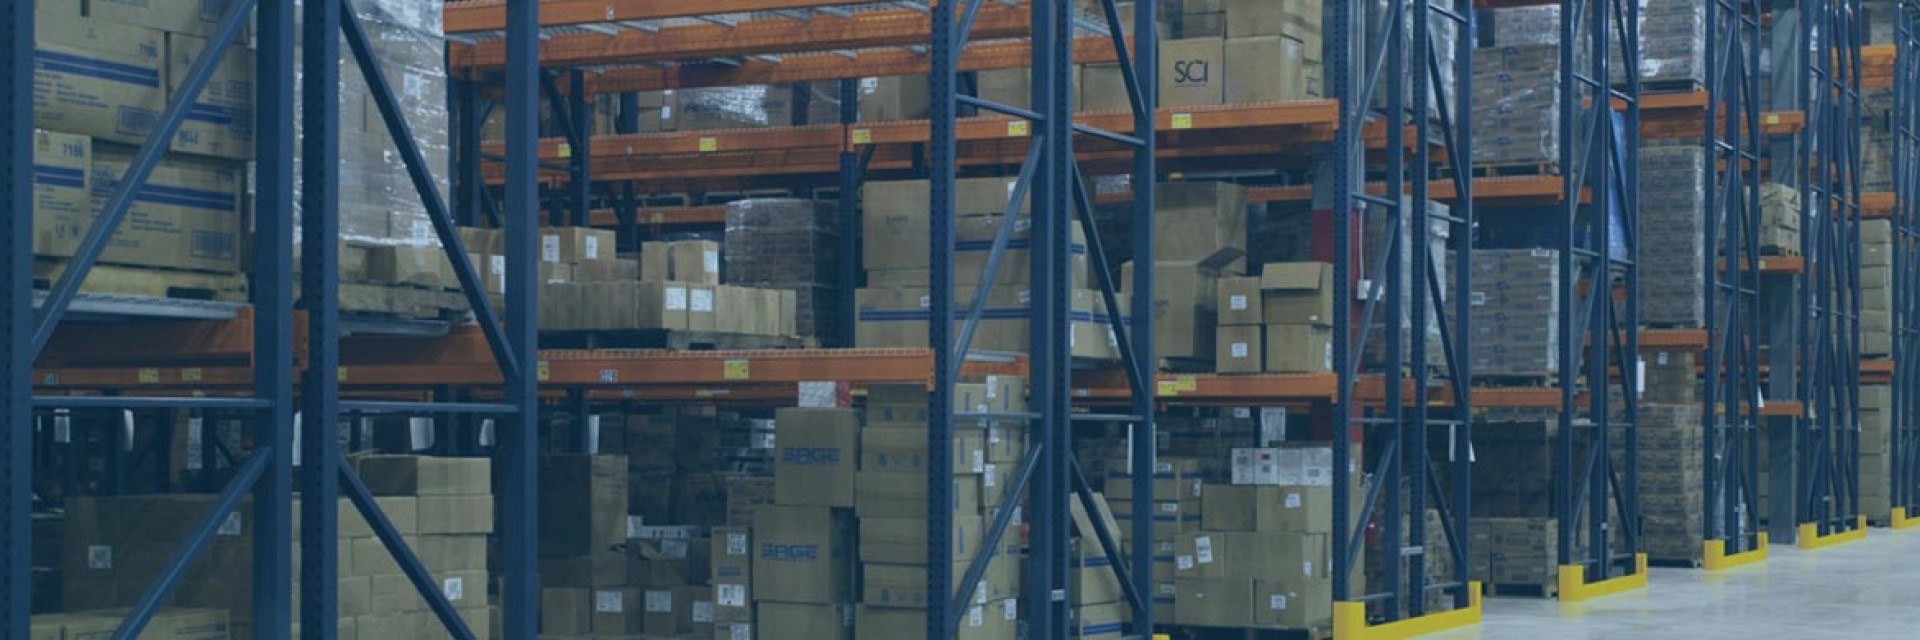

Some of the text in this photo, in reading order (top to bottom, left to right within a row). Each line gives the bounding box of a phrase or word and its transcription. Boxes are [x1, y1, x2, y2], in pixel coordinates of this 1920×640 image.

[1174, 59, 1209, 83] SCI
[781, 447, 841, 464] SAGE
[761, 543, 817, 560] SAGE
